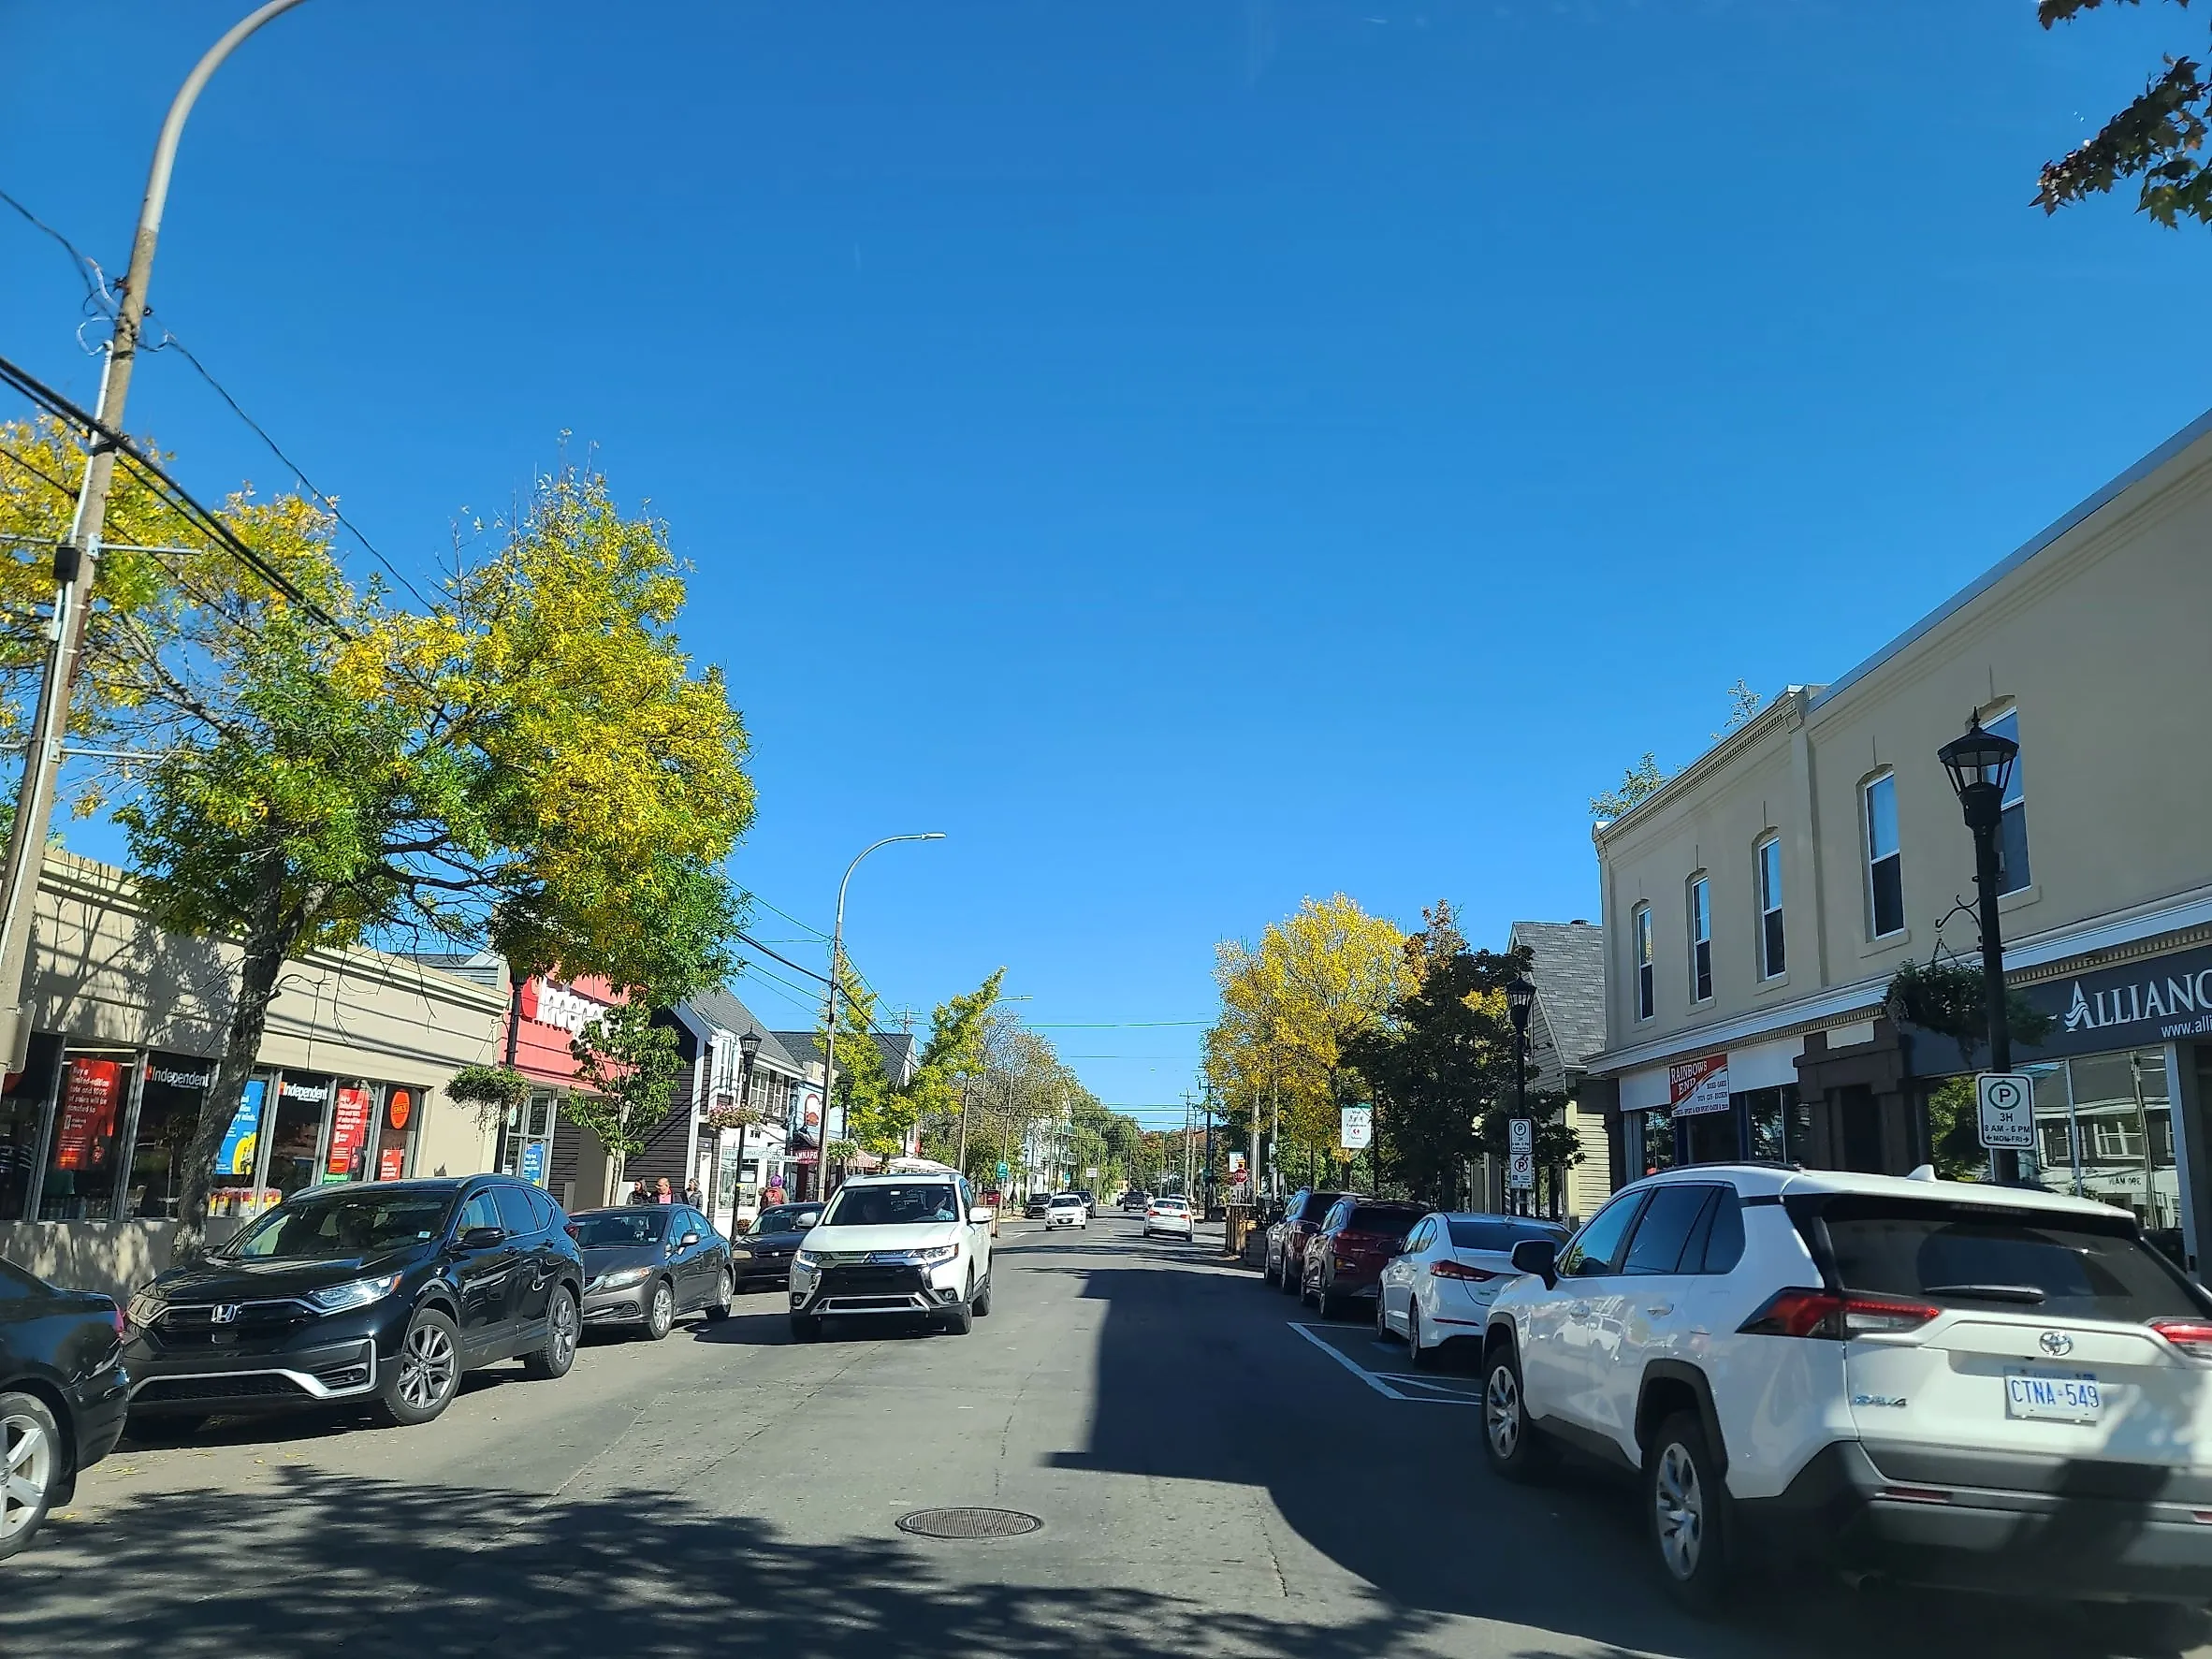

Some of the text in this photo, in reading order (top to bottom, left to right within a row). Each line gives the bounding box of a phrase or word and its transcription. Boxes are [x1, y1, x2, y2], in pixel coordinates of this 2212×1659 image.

[152, 1066, 210, 1088] Independent
[1671, 1060, 1708, 1084] RAINBOWS
[283, 1082, 328, 1100] Independent
[1678, 1078, 1696, 1096] END
[2000, 1113, 2014, 1122] 3H
